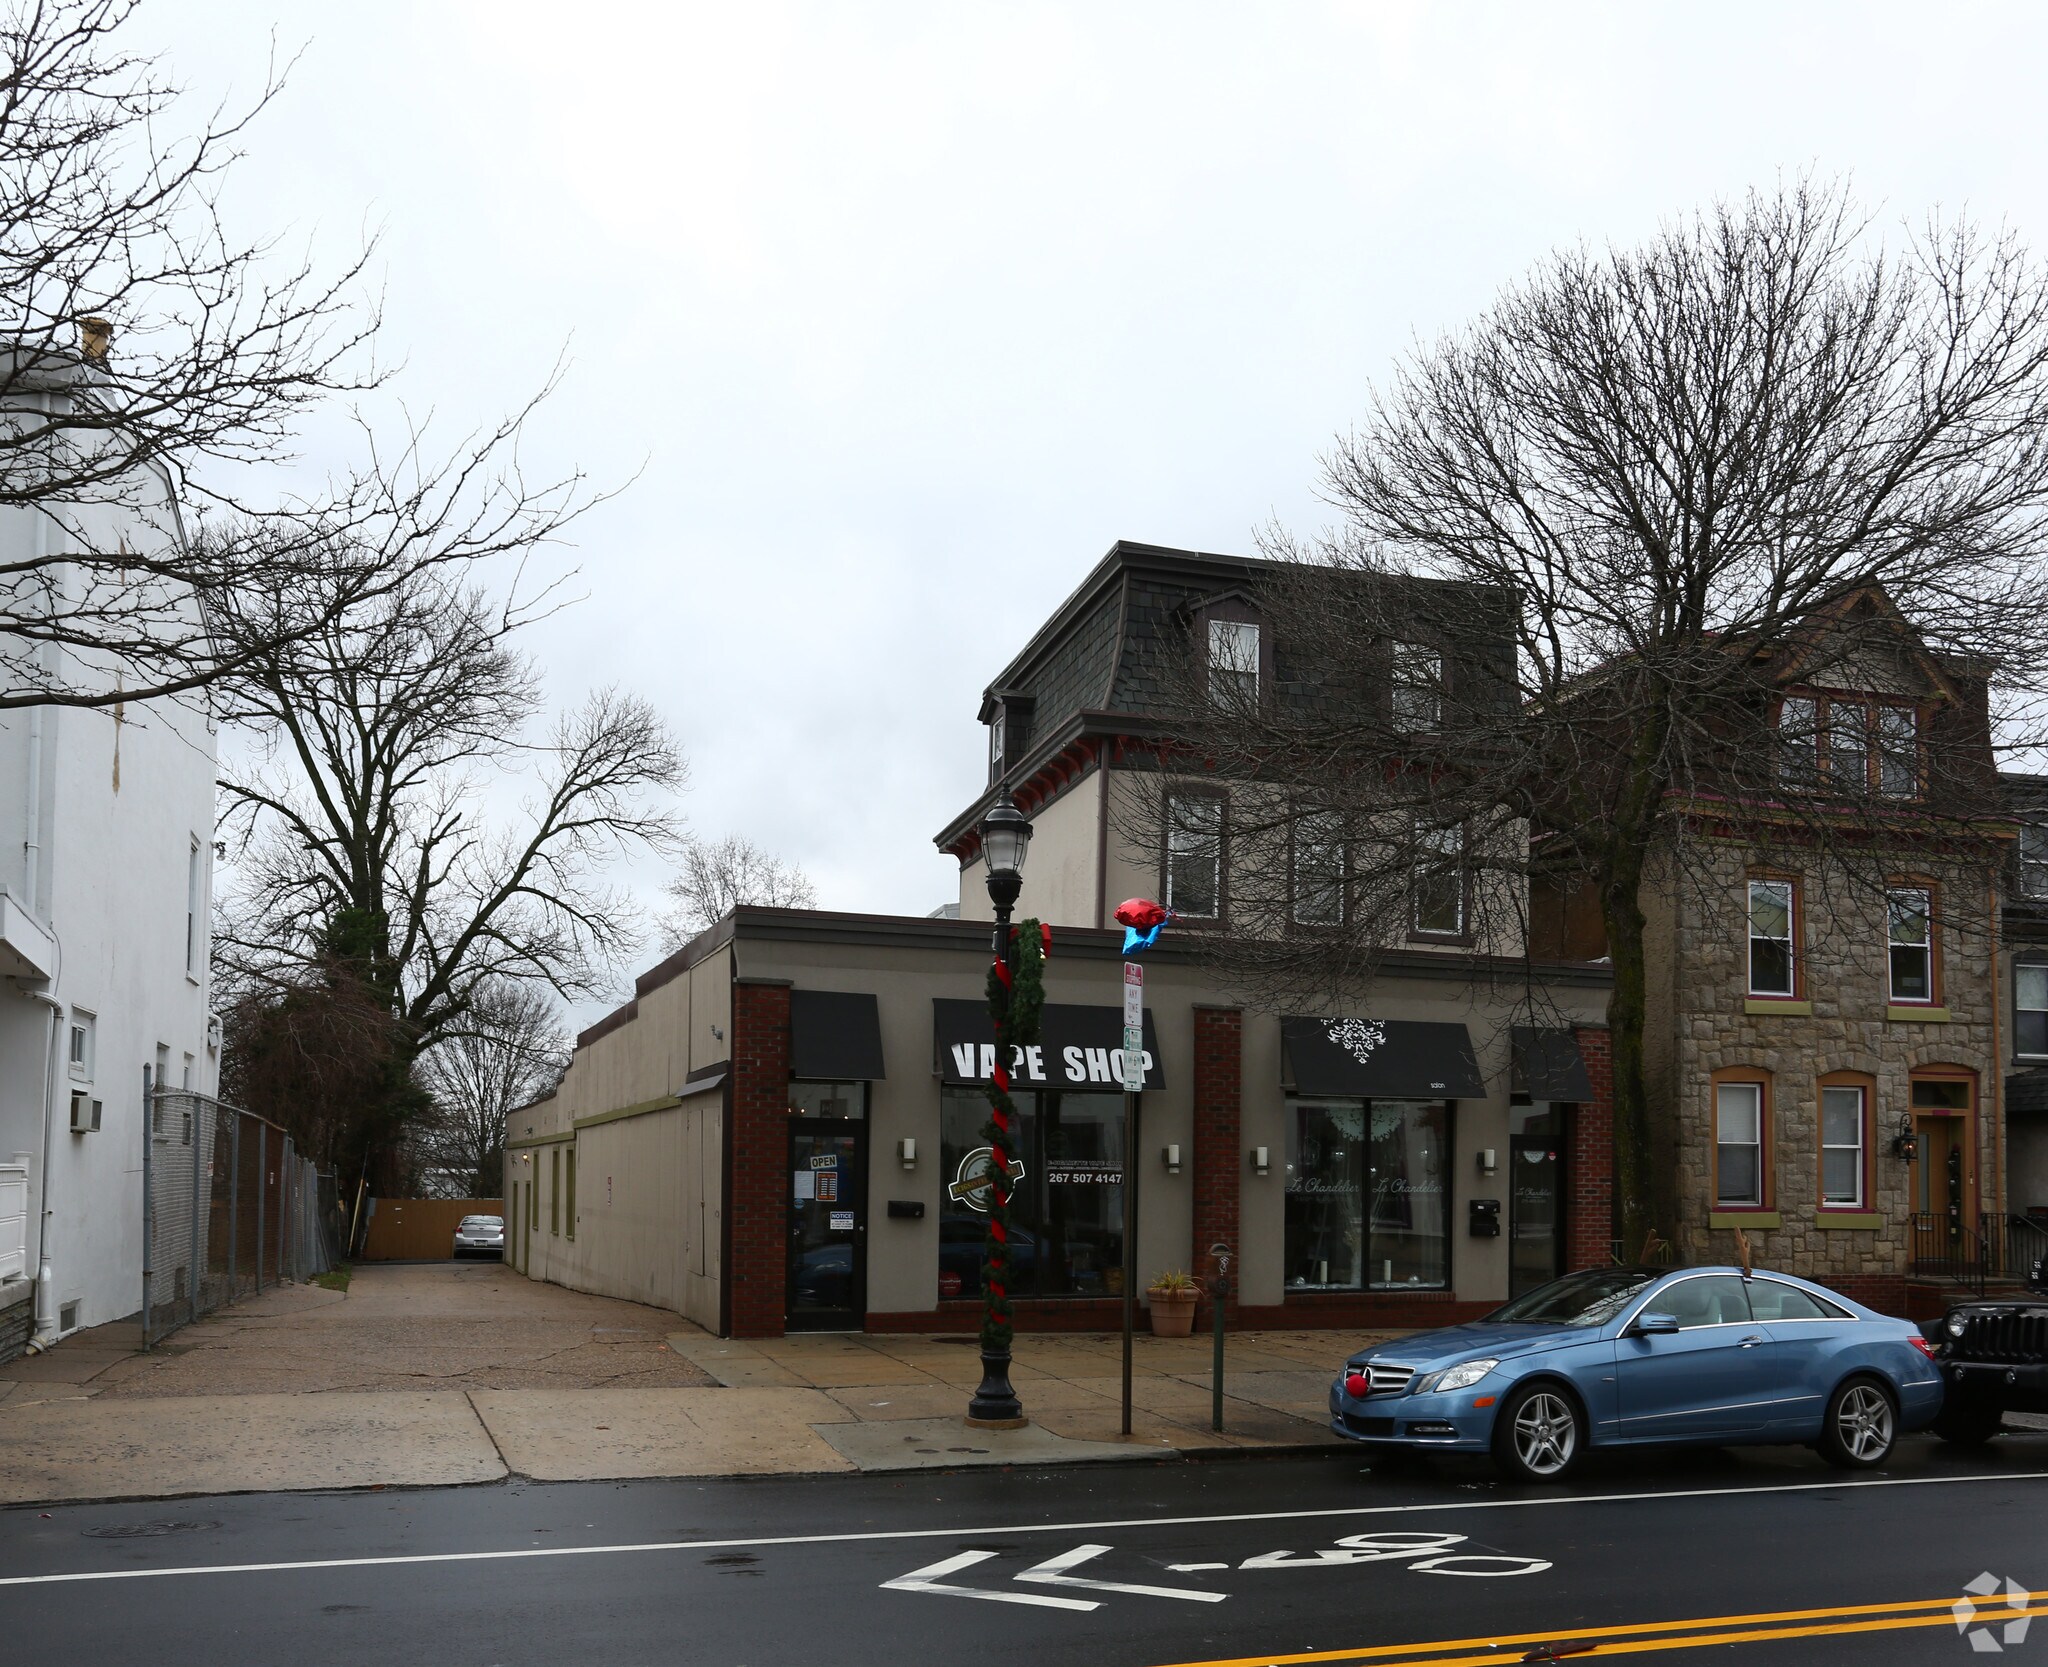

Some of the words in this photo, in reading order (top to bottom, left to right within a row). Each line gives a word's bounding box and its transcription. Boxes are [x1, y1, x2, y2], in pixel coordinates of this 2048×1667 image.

[1129, 989, 1138, 999] ANY
[951, 1043, 1047, 1081] VAPE
[1062, 1045, 1154, 1084] SHOP
[812, 1156, 836, 1168] OPEN
[1049, 1173, 1070, 1183] 267
[1072, 1173, 1093, 1183] 507
[1095, 1174, 1122, 1184] 4147
[1286, 1176, 1302, 1193] Le
[1304, 1177, 1360, 1193] Chandelier
[1372, 1177, 1388, 1193] Le
[1390, 1178, 1444, 1193] Chandelier
